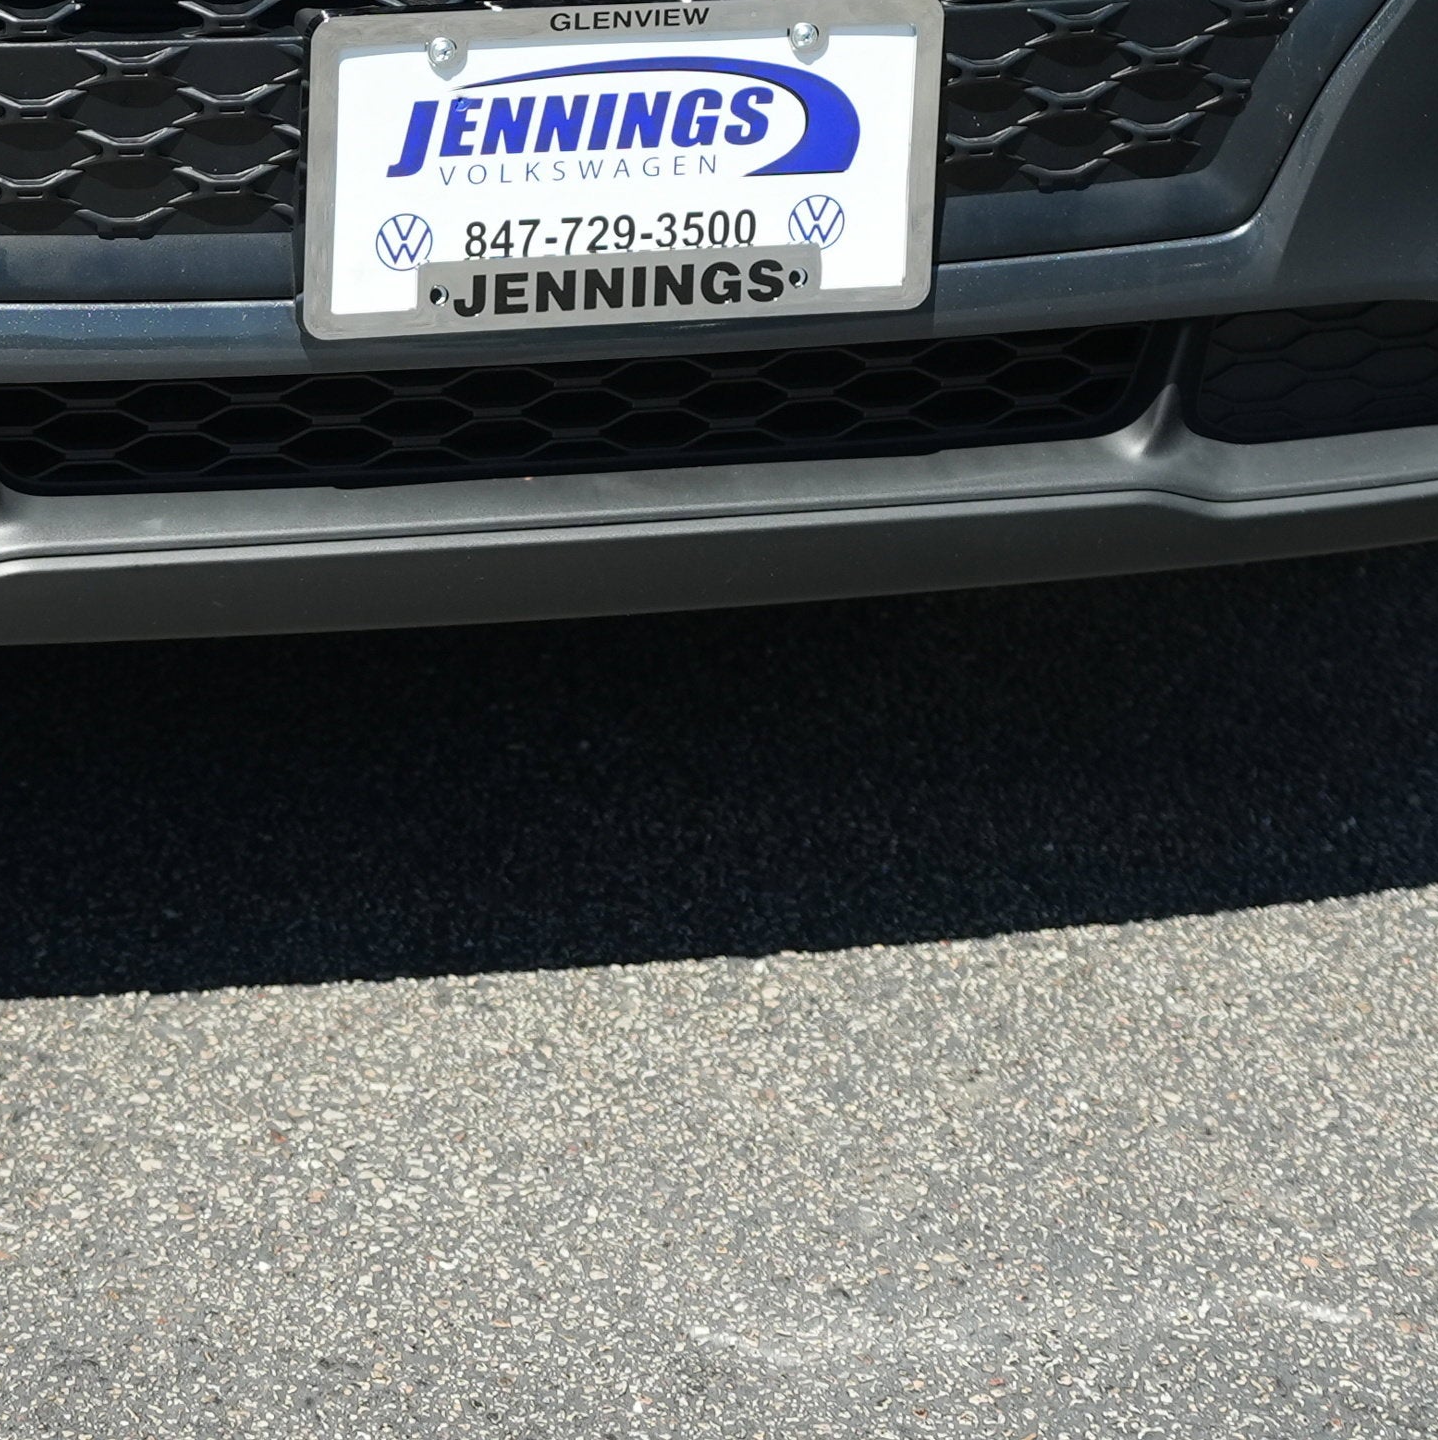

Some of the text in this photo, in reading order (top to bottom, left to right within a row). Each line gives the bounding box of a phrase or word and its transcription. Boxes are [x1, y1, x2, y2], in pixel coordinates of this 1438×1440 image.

[549, 7, 711, 31] GLENVIEW
[385, 86, 775, 178] JENNINGS
[439, 154, 717, 186] VOLKSWAGEN
[464, 209, 757, 258] 847-729-3500
[453, 259, 786, 317] JENNINGS
